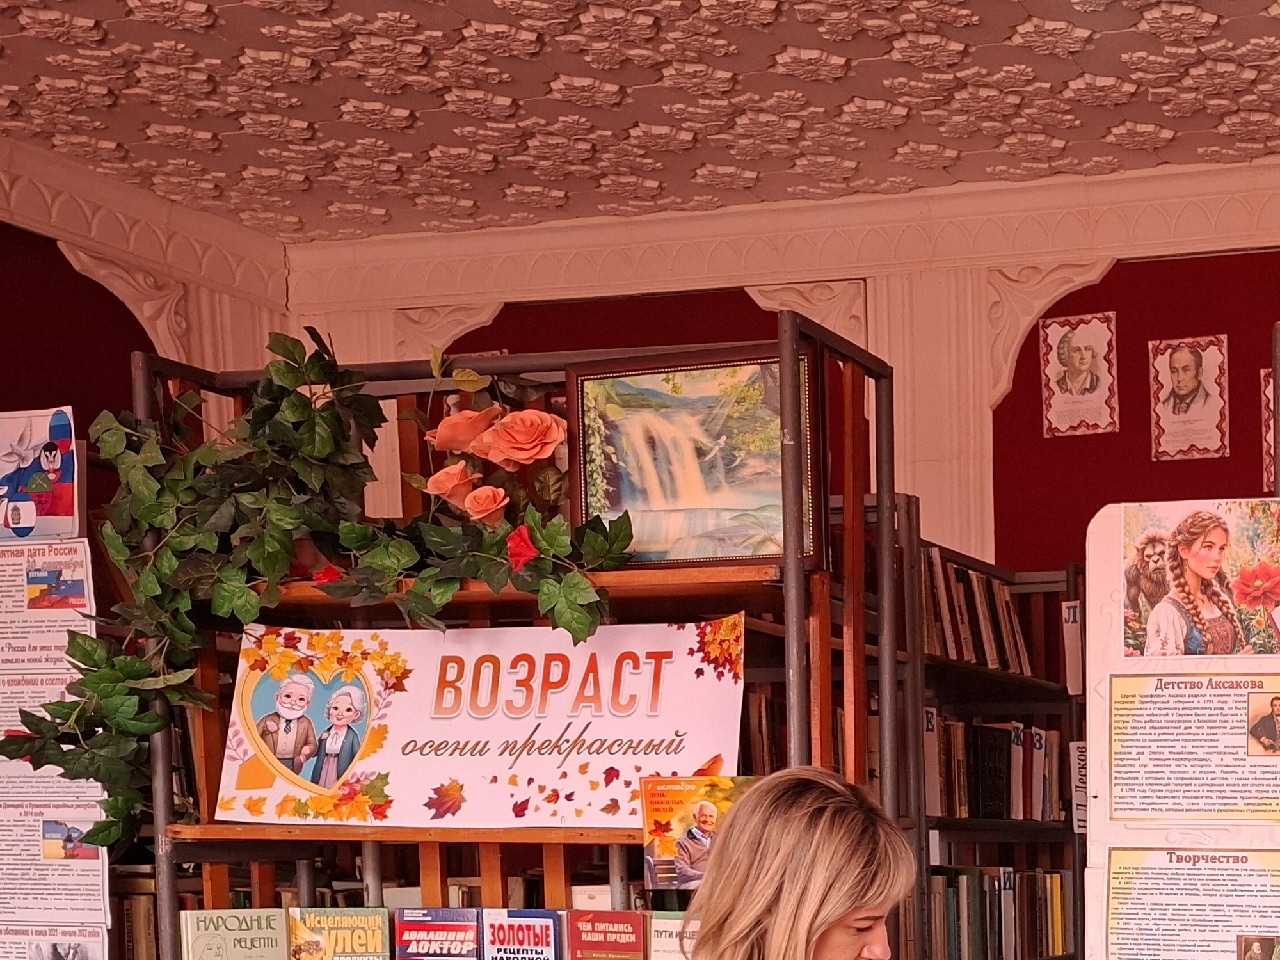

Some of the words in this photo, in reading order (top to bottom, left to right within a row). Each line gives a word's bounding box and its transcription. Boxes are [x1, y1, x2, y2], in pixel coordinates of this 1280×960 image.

[27, 547, 46, 559] дата
[48, 545, 78, 557] России
[1064, 606, 1078, 624] Л
[430, 649, 675, 719] ВОЗРАСТ
[1154, 678, 1204, 692] Детство
[1206, 678, 1264, 690] Аксакова
[925, 710, 935, 733] Е
[401, 735, 490, 758] осени
[498, 720, 688, 769] прекрасный
[657, 782, 696, 795] октября
[1167, 852, 1249, 866] Творчество
[196, 914, 277, 932] НАРОДНЫЕ
[305, 913, 382, 930] Исцеляющий
[577, 921, 592, 931] ЧЕМ
[595, 922, 633, 932] ПИТАЛИСЬ
[402, 929, 475, 941] ДОМАШНИЙ
[489, 923, 551, 947] ЗОЛОТЫЕ
[582, 933, 604, 942] НАШИ
[607, 933, 636, 944] ПРЕДКИ
[653, 930, 674, 939] ПУТИ
[233, 936, 278, 950] РЕЦЕПТЫ
[407, 941, 477, 954] ДОКТОР
[496, 947, 544, 956] РЕЦЕПТЫ
